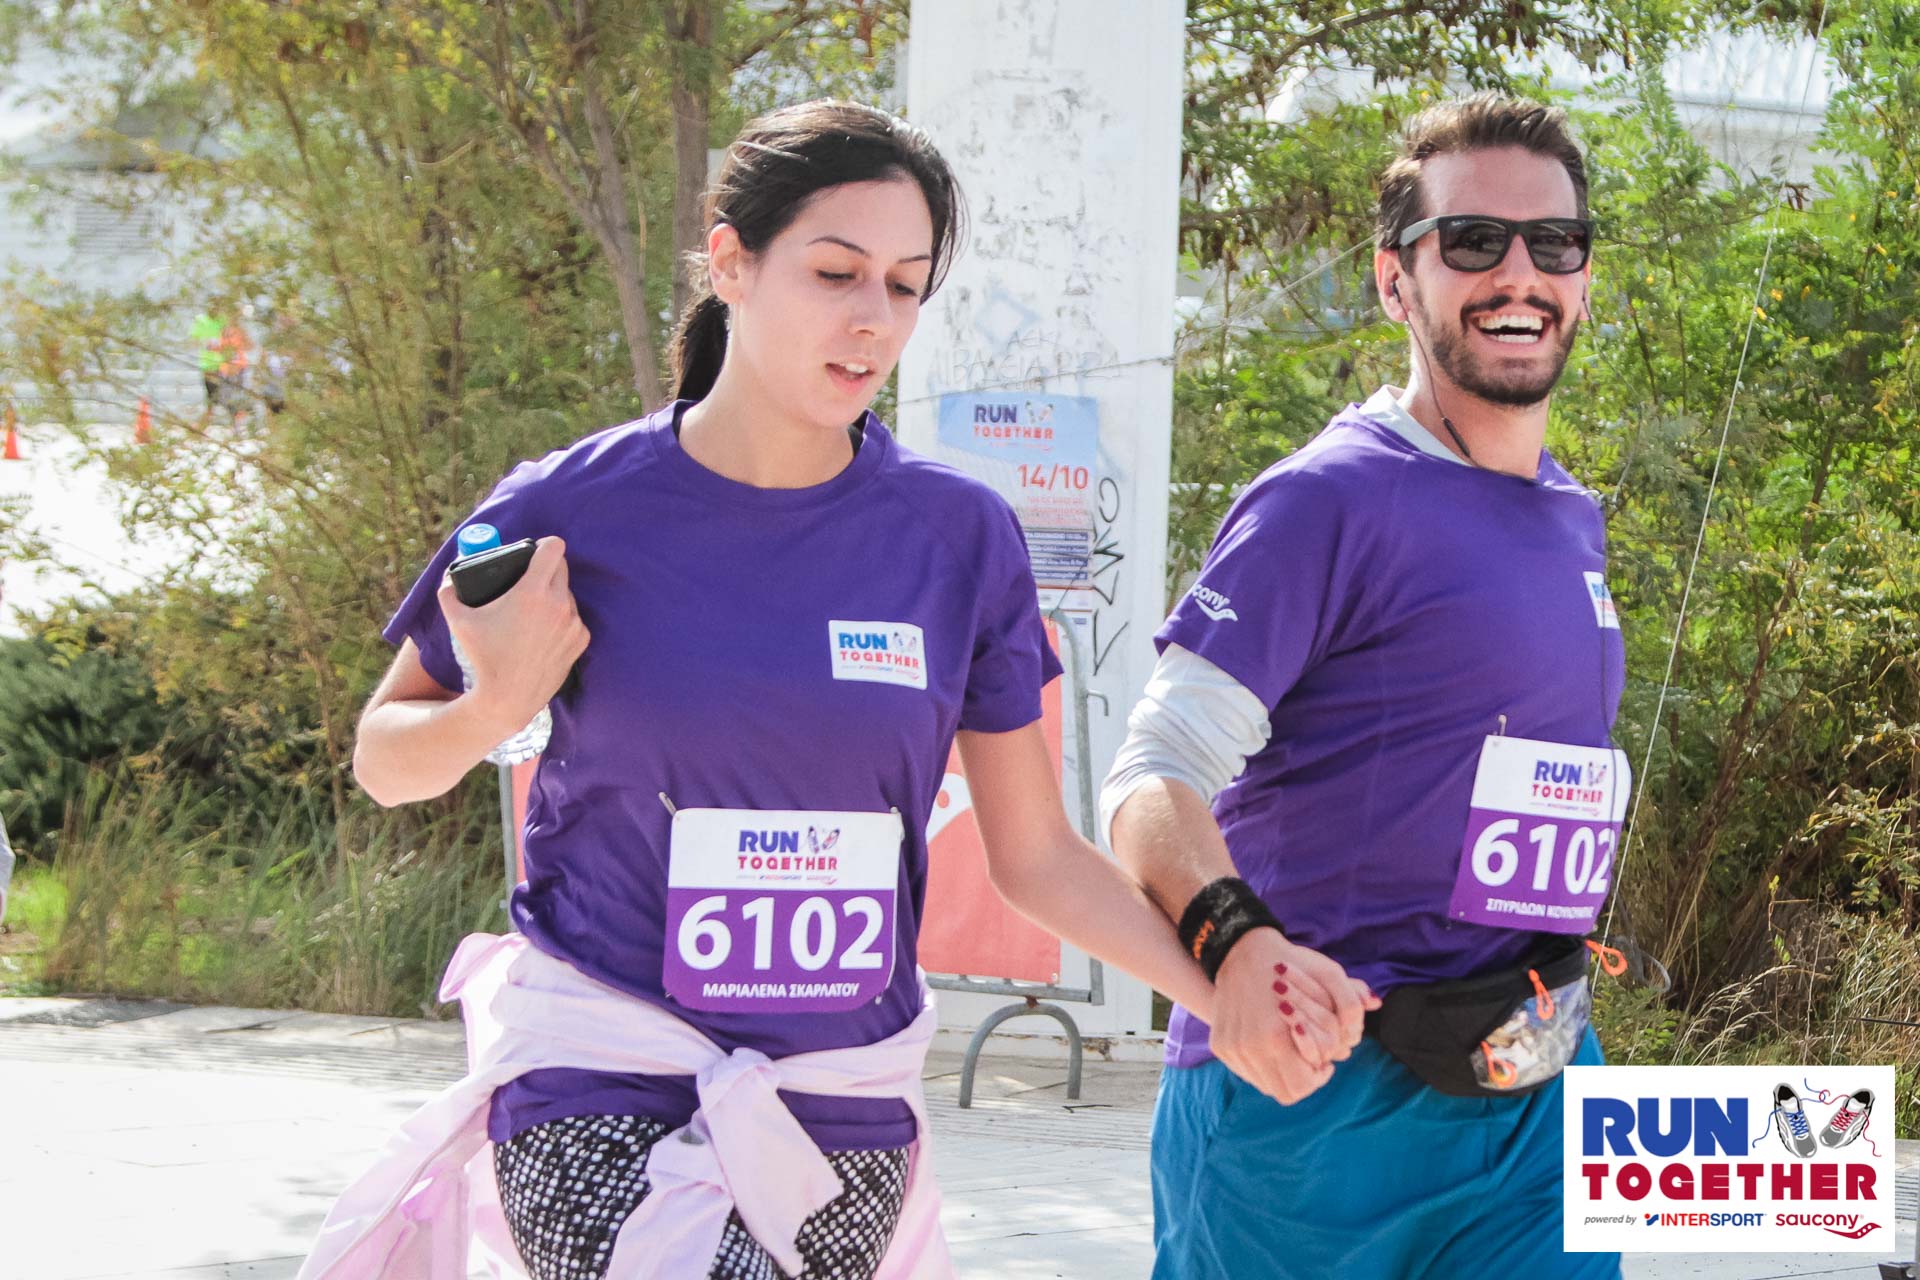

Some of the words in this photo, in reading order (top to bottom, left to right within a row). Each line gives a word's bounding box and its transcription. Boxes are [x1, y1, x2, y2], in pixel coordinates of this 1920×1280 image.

[974, 404, 1017, 423] RUN
[974, 425, 1054, 440] TOGETHER
[1018, 463, 1089, 491] 14/10
[838, 631, 888, 650] RUN
[840, 650, 919, 669] TOGETHER
[1534, 760, 1582, 785] RUN
[1532, 783, 1603, 803] TOGETHER
[738, 830, 799, 853] RUN
[737, 856, 838, 870] TOGETHER
[1471, 818, 1616, 895] 6102
[677, 895, 884, 971] 6102
